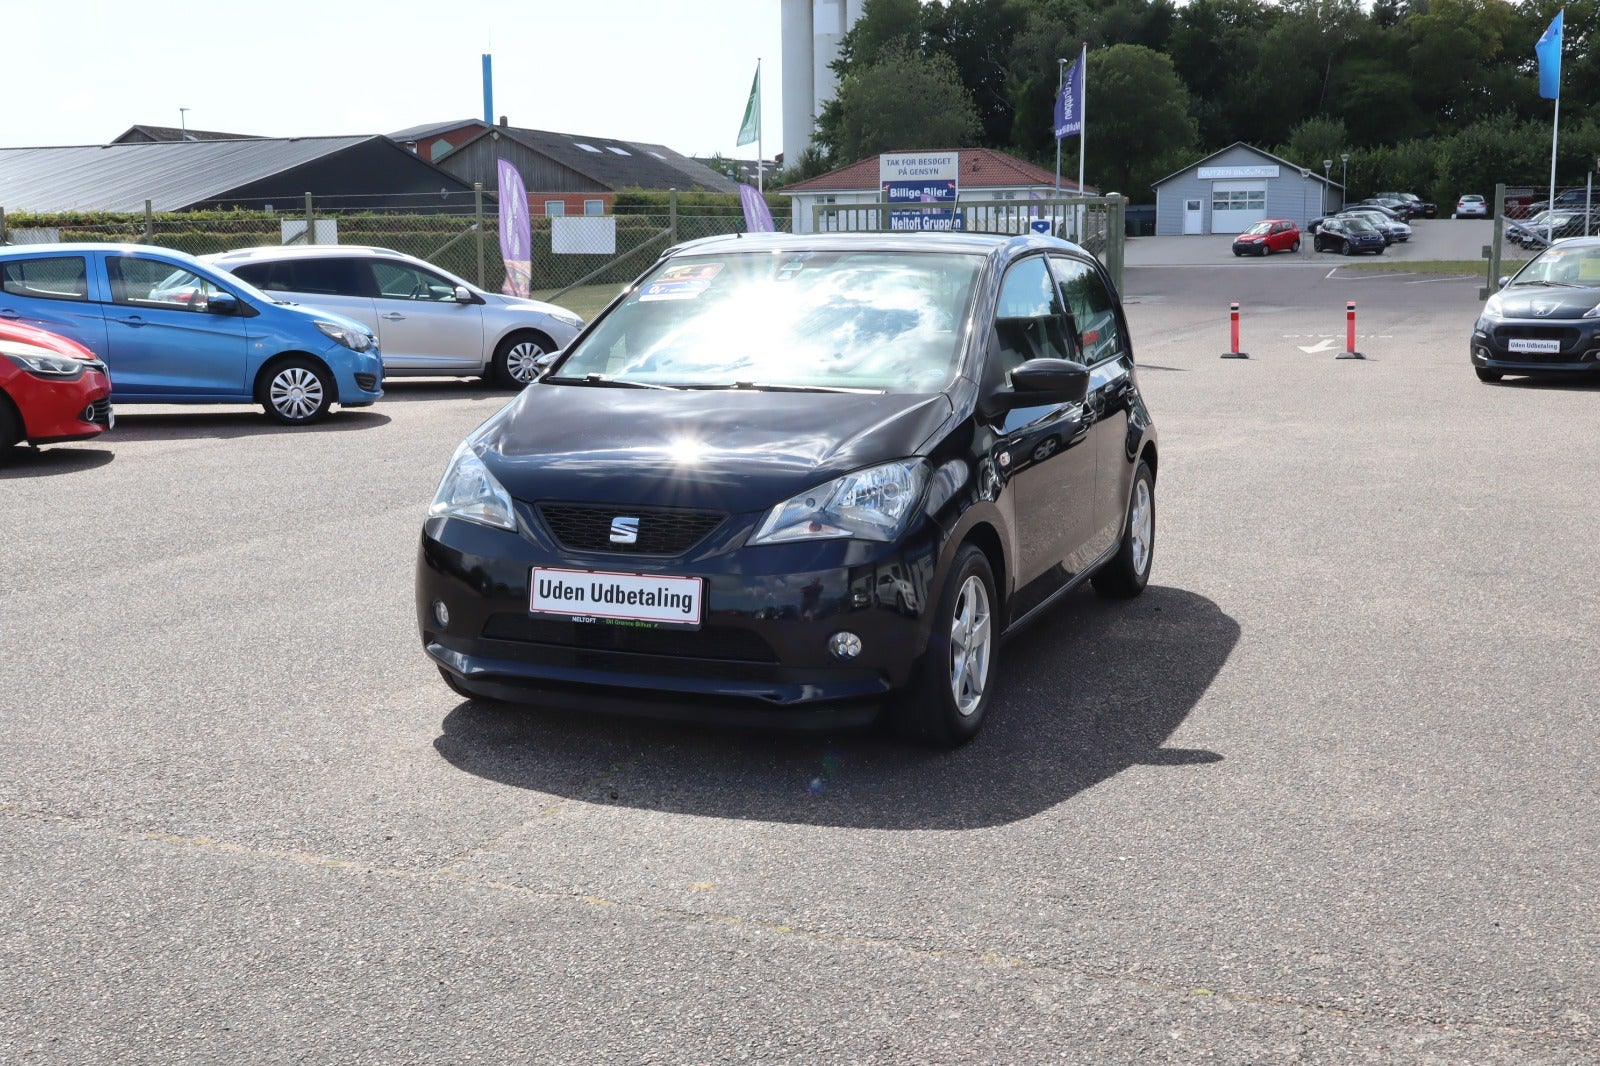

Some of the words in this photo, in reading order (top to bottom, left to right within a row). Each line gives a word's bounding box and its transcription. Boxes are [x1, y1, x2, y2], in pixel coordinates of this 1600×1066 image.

[886, 159, 900, 167] TAK
[918, 157, 951, 166] BESØGET
[898, 167, 907, 176] PÅ
[909, 168, 939, 176] GENSYN
[890, 187, 920, 199] Billige
[891, 216, 921, 230] Neltoft
[1526, 342, 1558, 351] Udbetaling
[539, 579, 585, 601] Uden
[590, 582, 693, 614] Udbetaling
